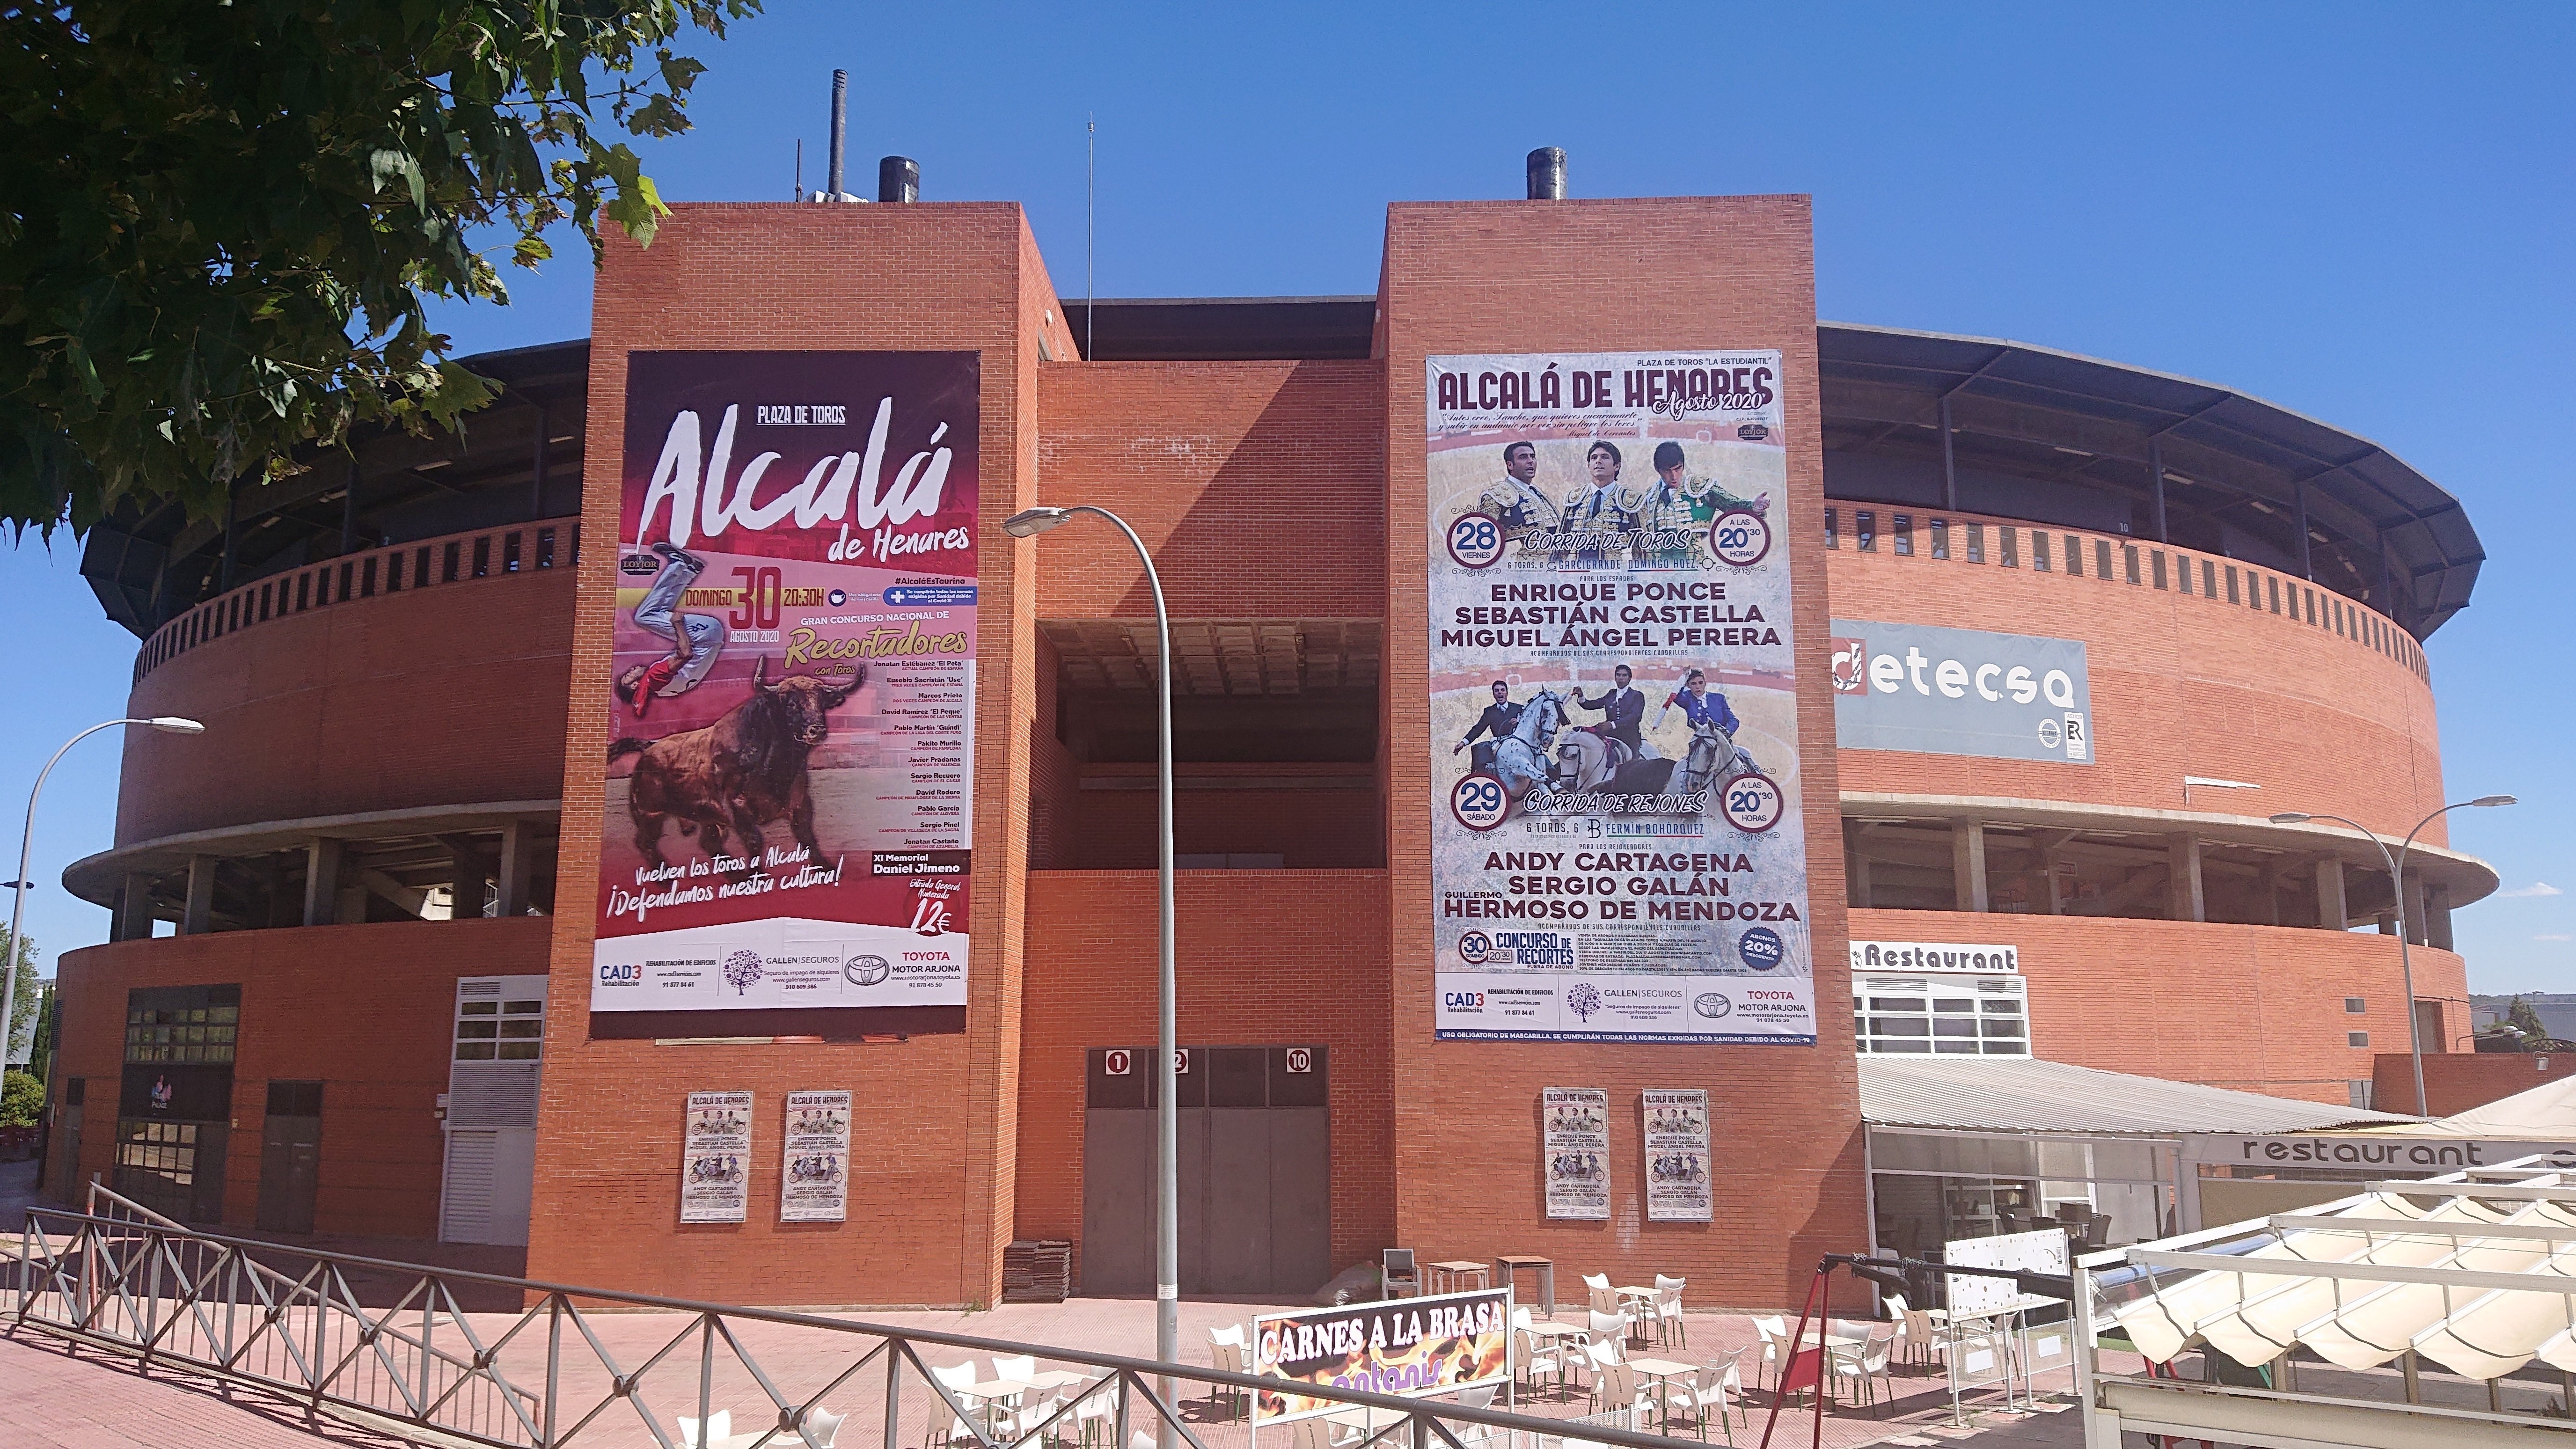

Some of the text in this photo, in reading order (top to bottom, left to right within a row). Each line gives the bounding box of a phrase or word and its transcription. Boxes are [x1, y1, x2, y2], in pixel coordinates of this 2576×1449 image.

[1438, 362, 1773, 410] ALCALÁ DE HENARES
[757, 405, 846, 424] PLAZA DE TOROS
[1653, 391, 1719, 421] Agosto
[1722, 393, 1763, 410] 2020
[637, 396, 952, 553] Alcalá
[828, 522, 970, 563] de Henares
[1456, 521, 1496, 551] 28
[1525, 528, 1690, 551] CORRIDA DE TOROS
[1559, 559, 1621, 570] GARCIGRANDE
[1628, 559, 1669, 569] DOMINGO
[686, 590, 732, 606] DOMINGO
[729, 566, 782, 629] 30
[784, 588, 825, 607] 20:30H
[1491, 582, 1726, 604] ENRIQUE PONCE
[800, 611, 950, 626] GRAN CONCURSO NACIONAL DE
[1455, 602, 1765, 624] SEBASTIÁN CASTELLA
[730, 630, 780, 643] AGOSTO 2020
[784, 620, 967, 669] Recortadores
[1442, 625, 1782, 648] MIGUEL ÁNGEL PERERA
[815, 663, 856, 675] con Toros
[1831, 642, 2074, 709] detecsa
[1460, 783, 1500, 812] 29
[1523, 788, 1707, 814] CORRIDA DE REJONES
[1466, 812, 1495, 821] SÁBADO
[1526, 820, 1705, 834] 6 TOROS, 6 FERMÍN BOHÓRQUEZ
[635, 842, 810, 886] Vuelven los toros a Alcalá
[873, 864, 960, 874] Daniel Jimeno
[1484, 852, 1754, 872] ANDY CARTAGENA
[607, 854, 845, 922] ¡Defendamos nuestra cultura!
[1508, 872, 1729, 896] SERGIO GALÁN
[1444, 891, 1502, 899] GUILLERMO
[907, 898, 952, 934] 12€
[1444, 899, 1800, 922] HERMOSO DE MENDOZA
[1464, 937, 1487, 953] 30
[1496, 932, 1571, 949] CONCURSO DE
[1749, 933, 1776, 943] ABONOS
[902, 951, 950, 961] TOYOTA
[1744, 939, 1778, 956] 20%
[1746, 951, 1774, 961] DESCUENTO
[1517, 948, 1573, 965] RECORTES
[1865, 944, 2015, 970] Restaurant
[1445, 992, 1484, 1007] CAD3
[1747, 990, 1795, 1000] TOYOTA
[1738, 1003, 1806, 1012] MOTOR ARJONA
[1114, 1055, 1121, 1069] 1
[1175, 1054, 1182, 1068] 2
[1292, 1054, 1307, 1068] 10
[692, 1095, 714, 1105] ALCALÁ
[791, 1094, 812, 1105] ALCALÁ
[1546, 1091, 1568, 1102] ALCALÁ
[1645, 1093, 1666, 1103] ALCALÁ
[2243, 1139, 2483, 1166] restaurant
[1261, 1315, 1366, 1365] CARNES
[1368, 1315, 1387, 1349] A
[1392, 1310, 1423, 1345] LA
[1429, 1300, 1506, 1340] BRASA
